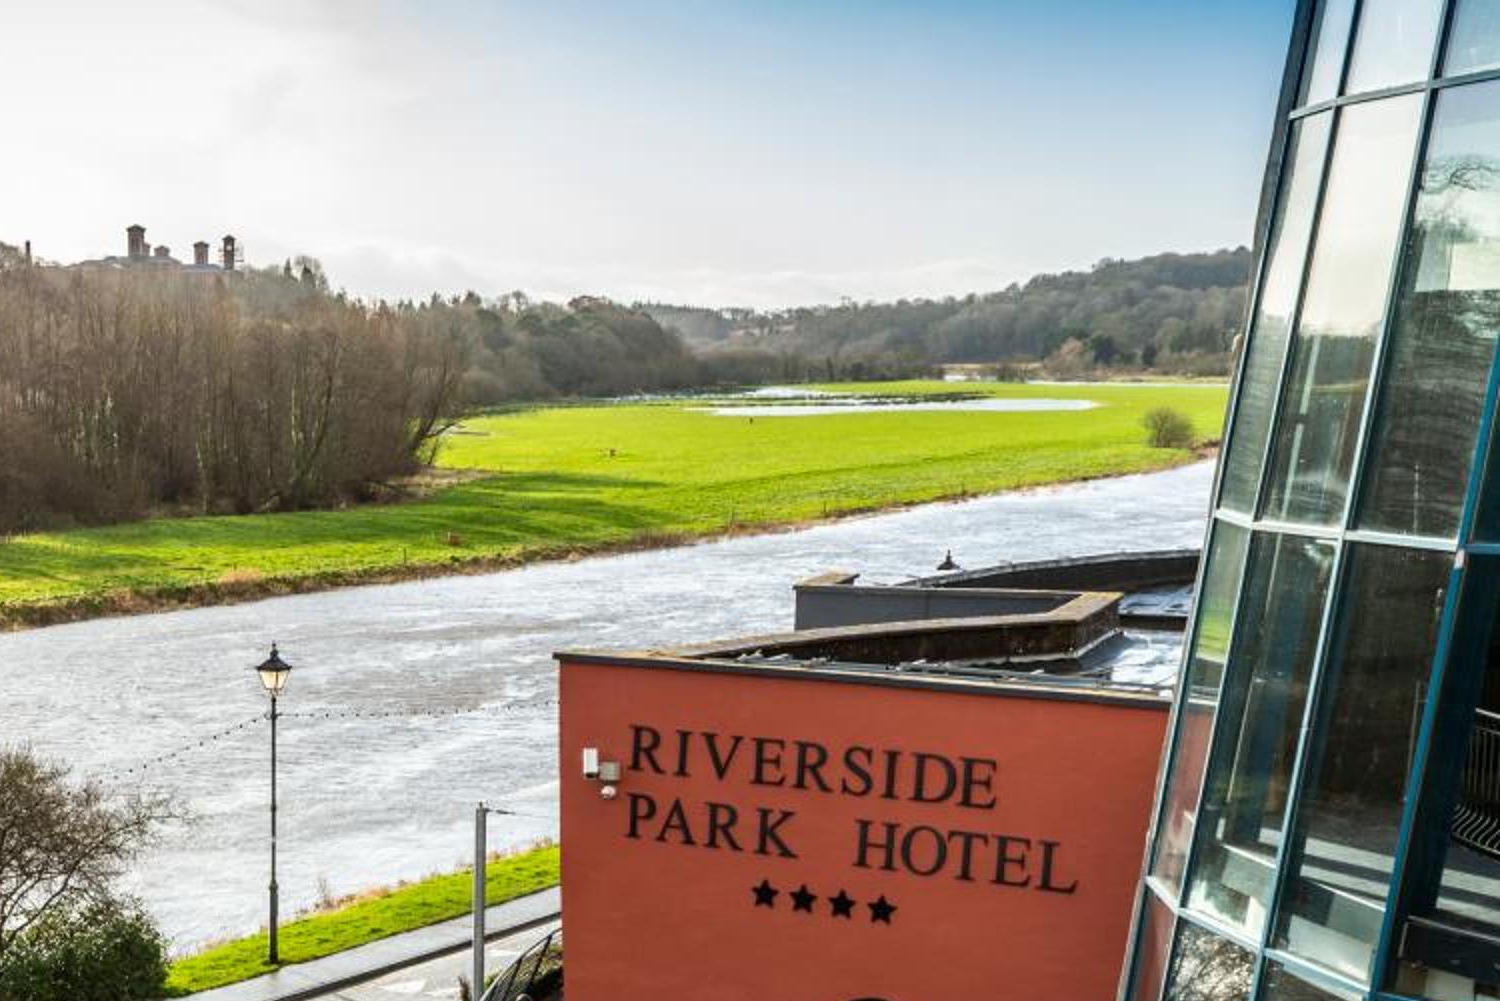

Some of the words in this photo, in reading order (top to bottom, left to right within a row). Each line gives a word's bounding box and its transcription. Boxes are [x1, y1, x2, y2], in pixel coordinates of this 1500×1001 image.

[627, 725, 998, 810] RIVERSIDE
[624, 792, 799, 859] PARK
[852, 819, 1080, 896] HOTEL
